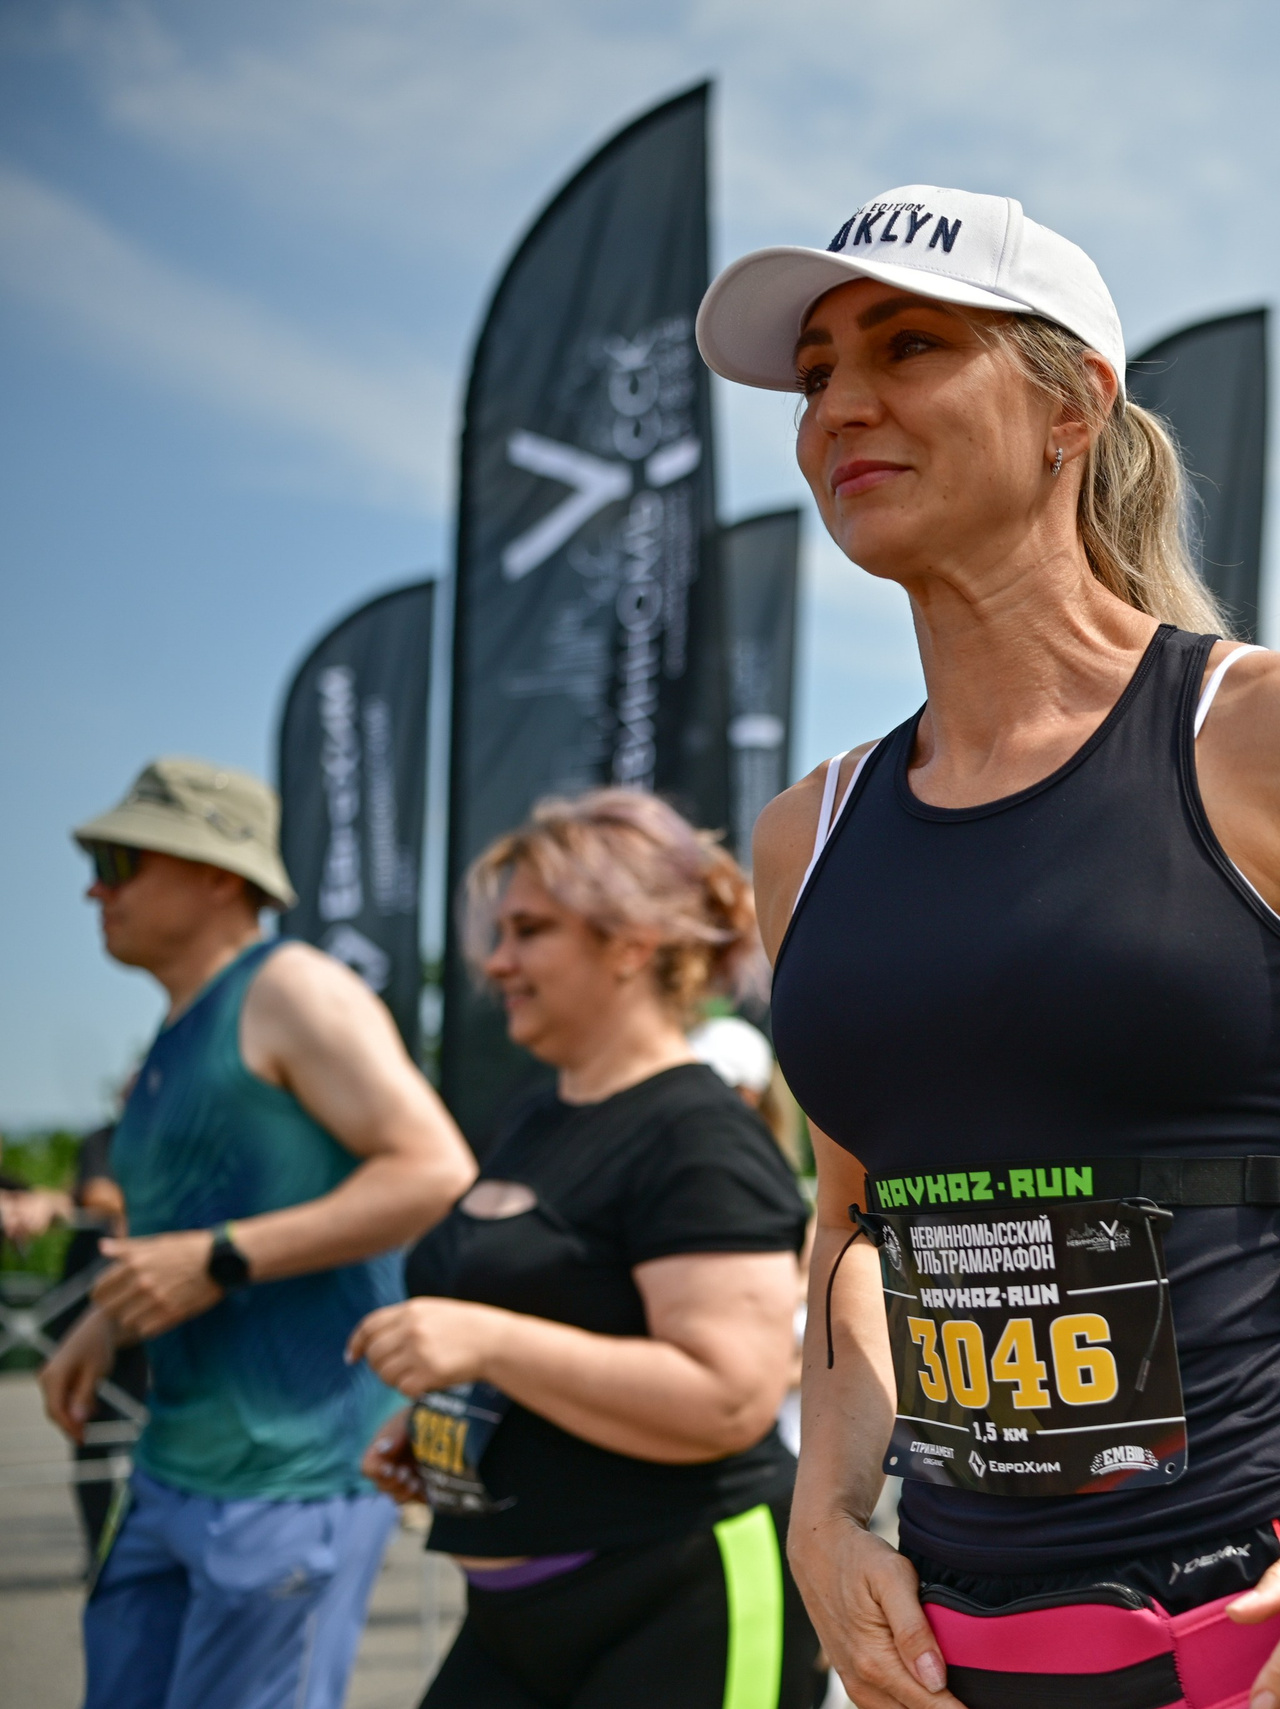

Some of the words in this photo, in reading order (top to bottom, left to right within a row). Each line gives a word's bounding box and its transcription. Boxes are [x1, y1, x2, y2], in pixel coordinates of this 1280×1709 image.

[870, 202, 925, 212] EDITION
[826, 211, 962, 253] OKLYN
[910, 1214, 1053, 1250] НЕВИННОМЫССКИЙ
[913, 1245, 1055, 1275] УЛЬТРАМАРАФОН
[907, 1313, 1119, 1410] 3046
[972, 1421, 998, 1444] 1,5
